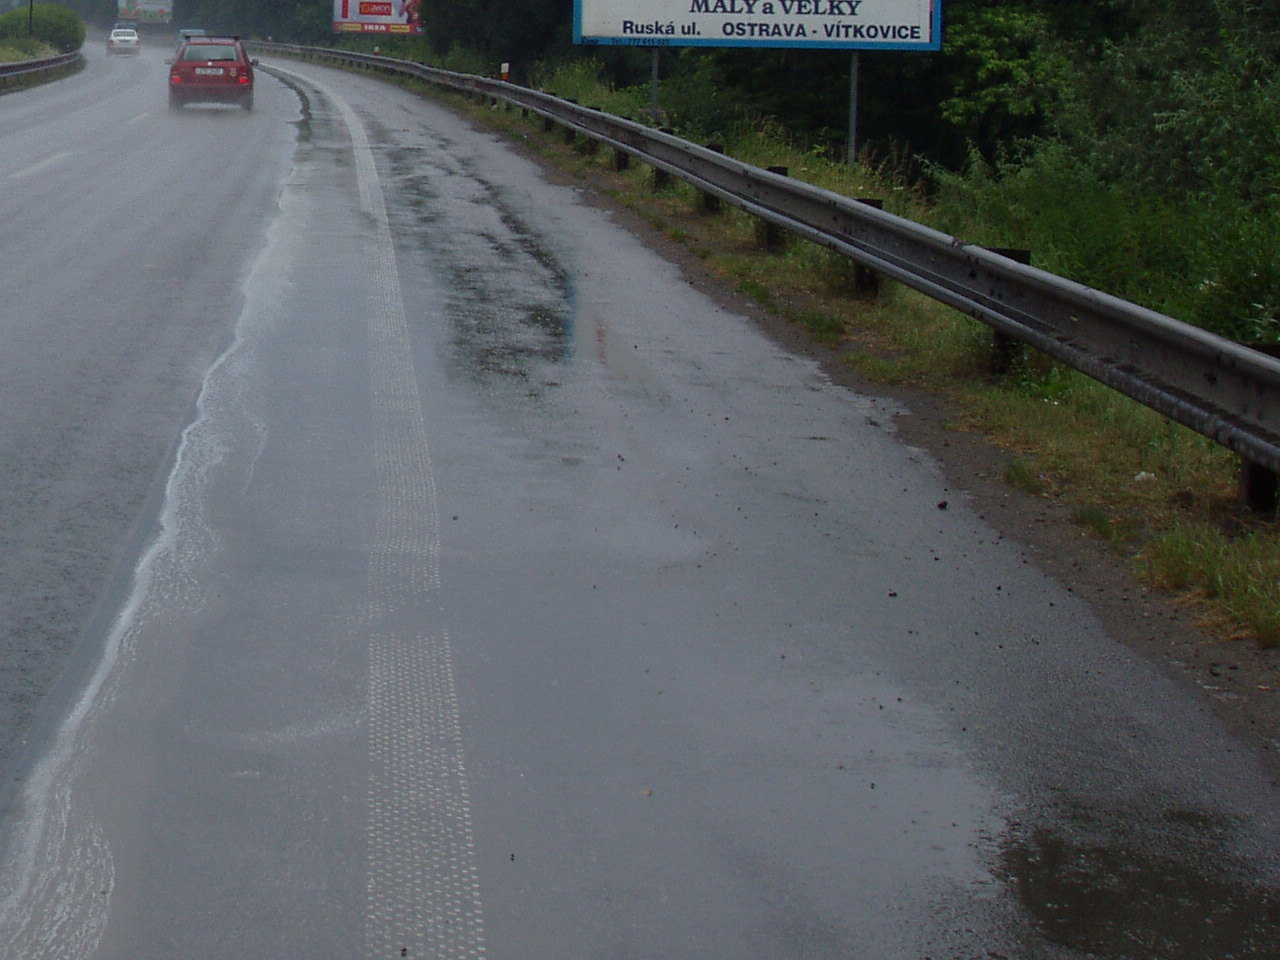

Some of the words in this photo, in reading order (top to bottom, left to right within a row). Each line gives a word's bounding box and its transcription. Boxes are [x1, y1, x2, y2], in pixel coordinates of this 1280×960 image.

[762, 1, 774, 14] a
[622, 20, 675, 35] Ruská
[681, 22, 701, 35] ul.
[722, 22, 807, 37] OSTRAVA
[823, 21, 921, 39] VÍTKOVICE
